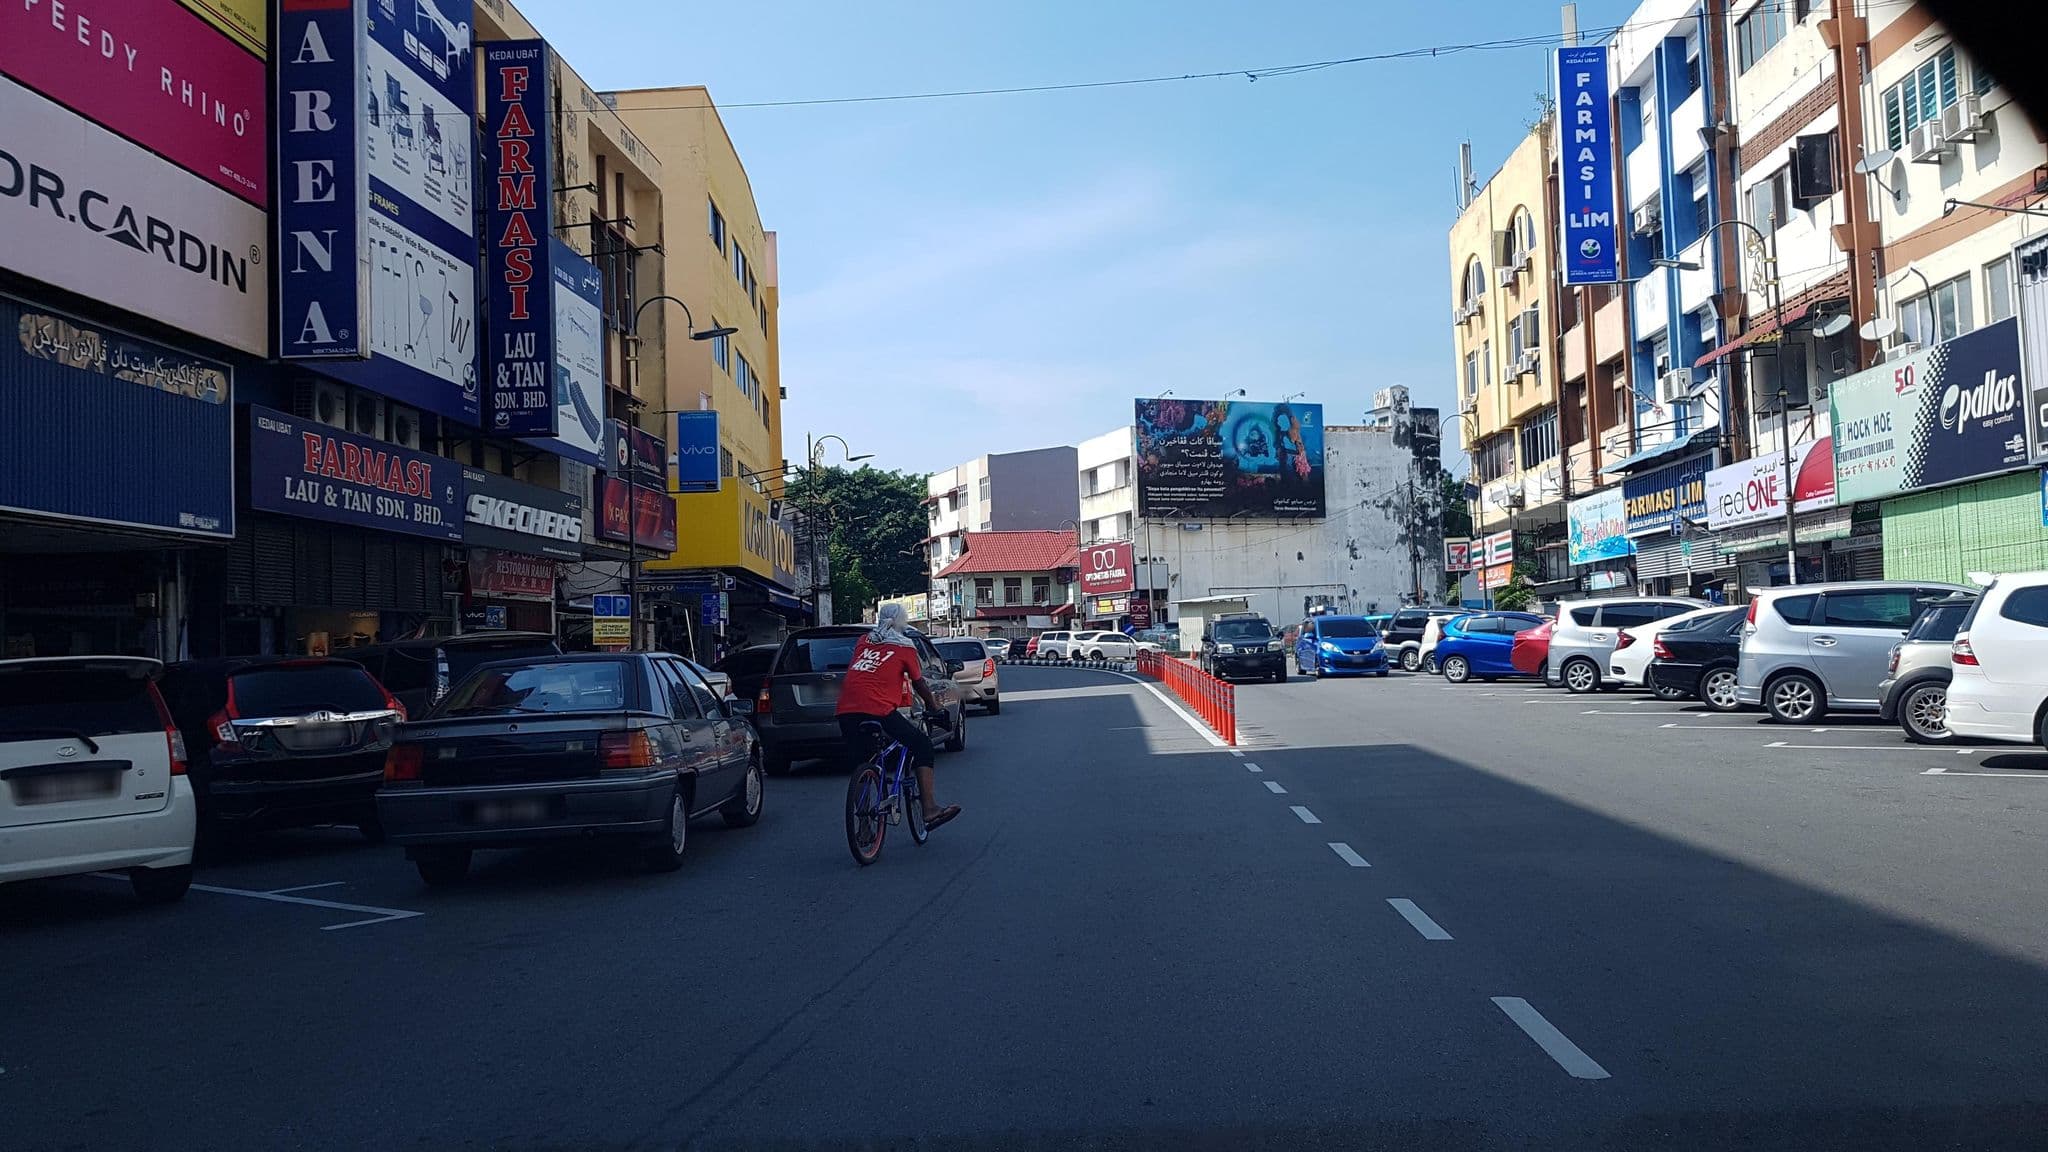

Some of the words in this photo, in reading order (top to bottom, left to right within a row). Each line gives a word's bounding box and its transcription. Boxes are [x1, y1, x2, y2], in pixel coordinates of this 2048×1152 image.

[489, 50, 514, 61] KEDAI
[516, 49, 539, 59] UBAT
[1575, 72, 1596, 200] FARMASI
[497, 66, 537, 319] FARMASI
[504, 332, 536, 359] LAU
[496, 362, 510, 388] &
[512, 361, 545, 387] TAN
[494, 391, 519, 409] SDN.
[523, 390, 548, 408] BHD.
[1958, 369, 2016, 434] pallas
[257, 416, 275, 431] KEDAI
[277, 421, 292, 435] UBAT
[1847, 419, 1869, 441] HOCK
[1873, 411, 1892, 434] HOE
[1983, 419, 1994, 428] easy
[1994, 413, 2014, 425] comfort
[681, 444, 715, 455] vivo
[303, 431, 432, 500] FARMASI
[285, 476, 319, 503] LAU
[324, 483, 338, 508] &
[341, 488, 372, 514] TAN
[376, 495, 409, 521] SDN.
[413, 504, 444, 528] BHD.
[1624, 487, 1675, 518] FARMASI
[1679, 479, 1704, 505] LIM
[465, 493, 583, 544] SKECHERS
[496, 560, 530, 577] RESTORAN
[725, 577, 734, 589] P
[615, 597, 627, 615] P
